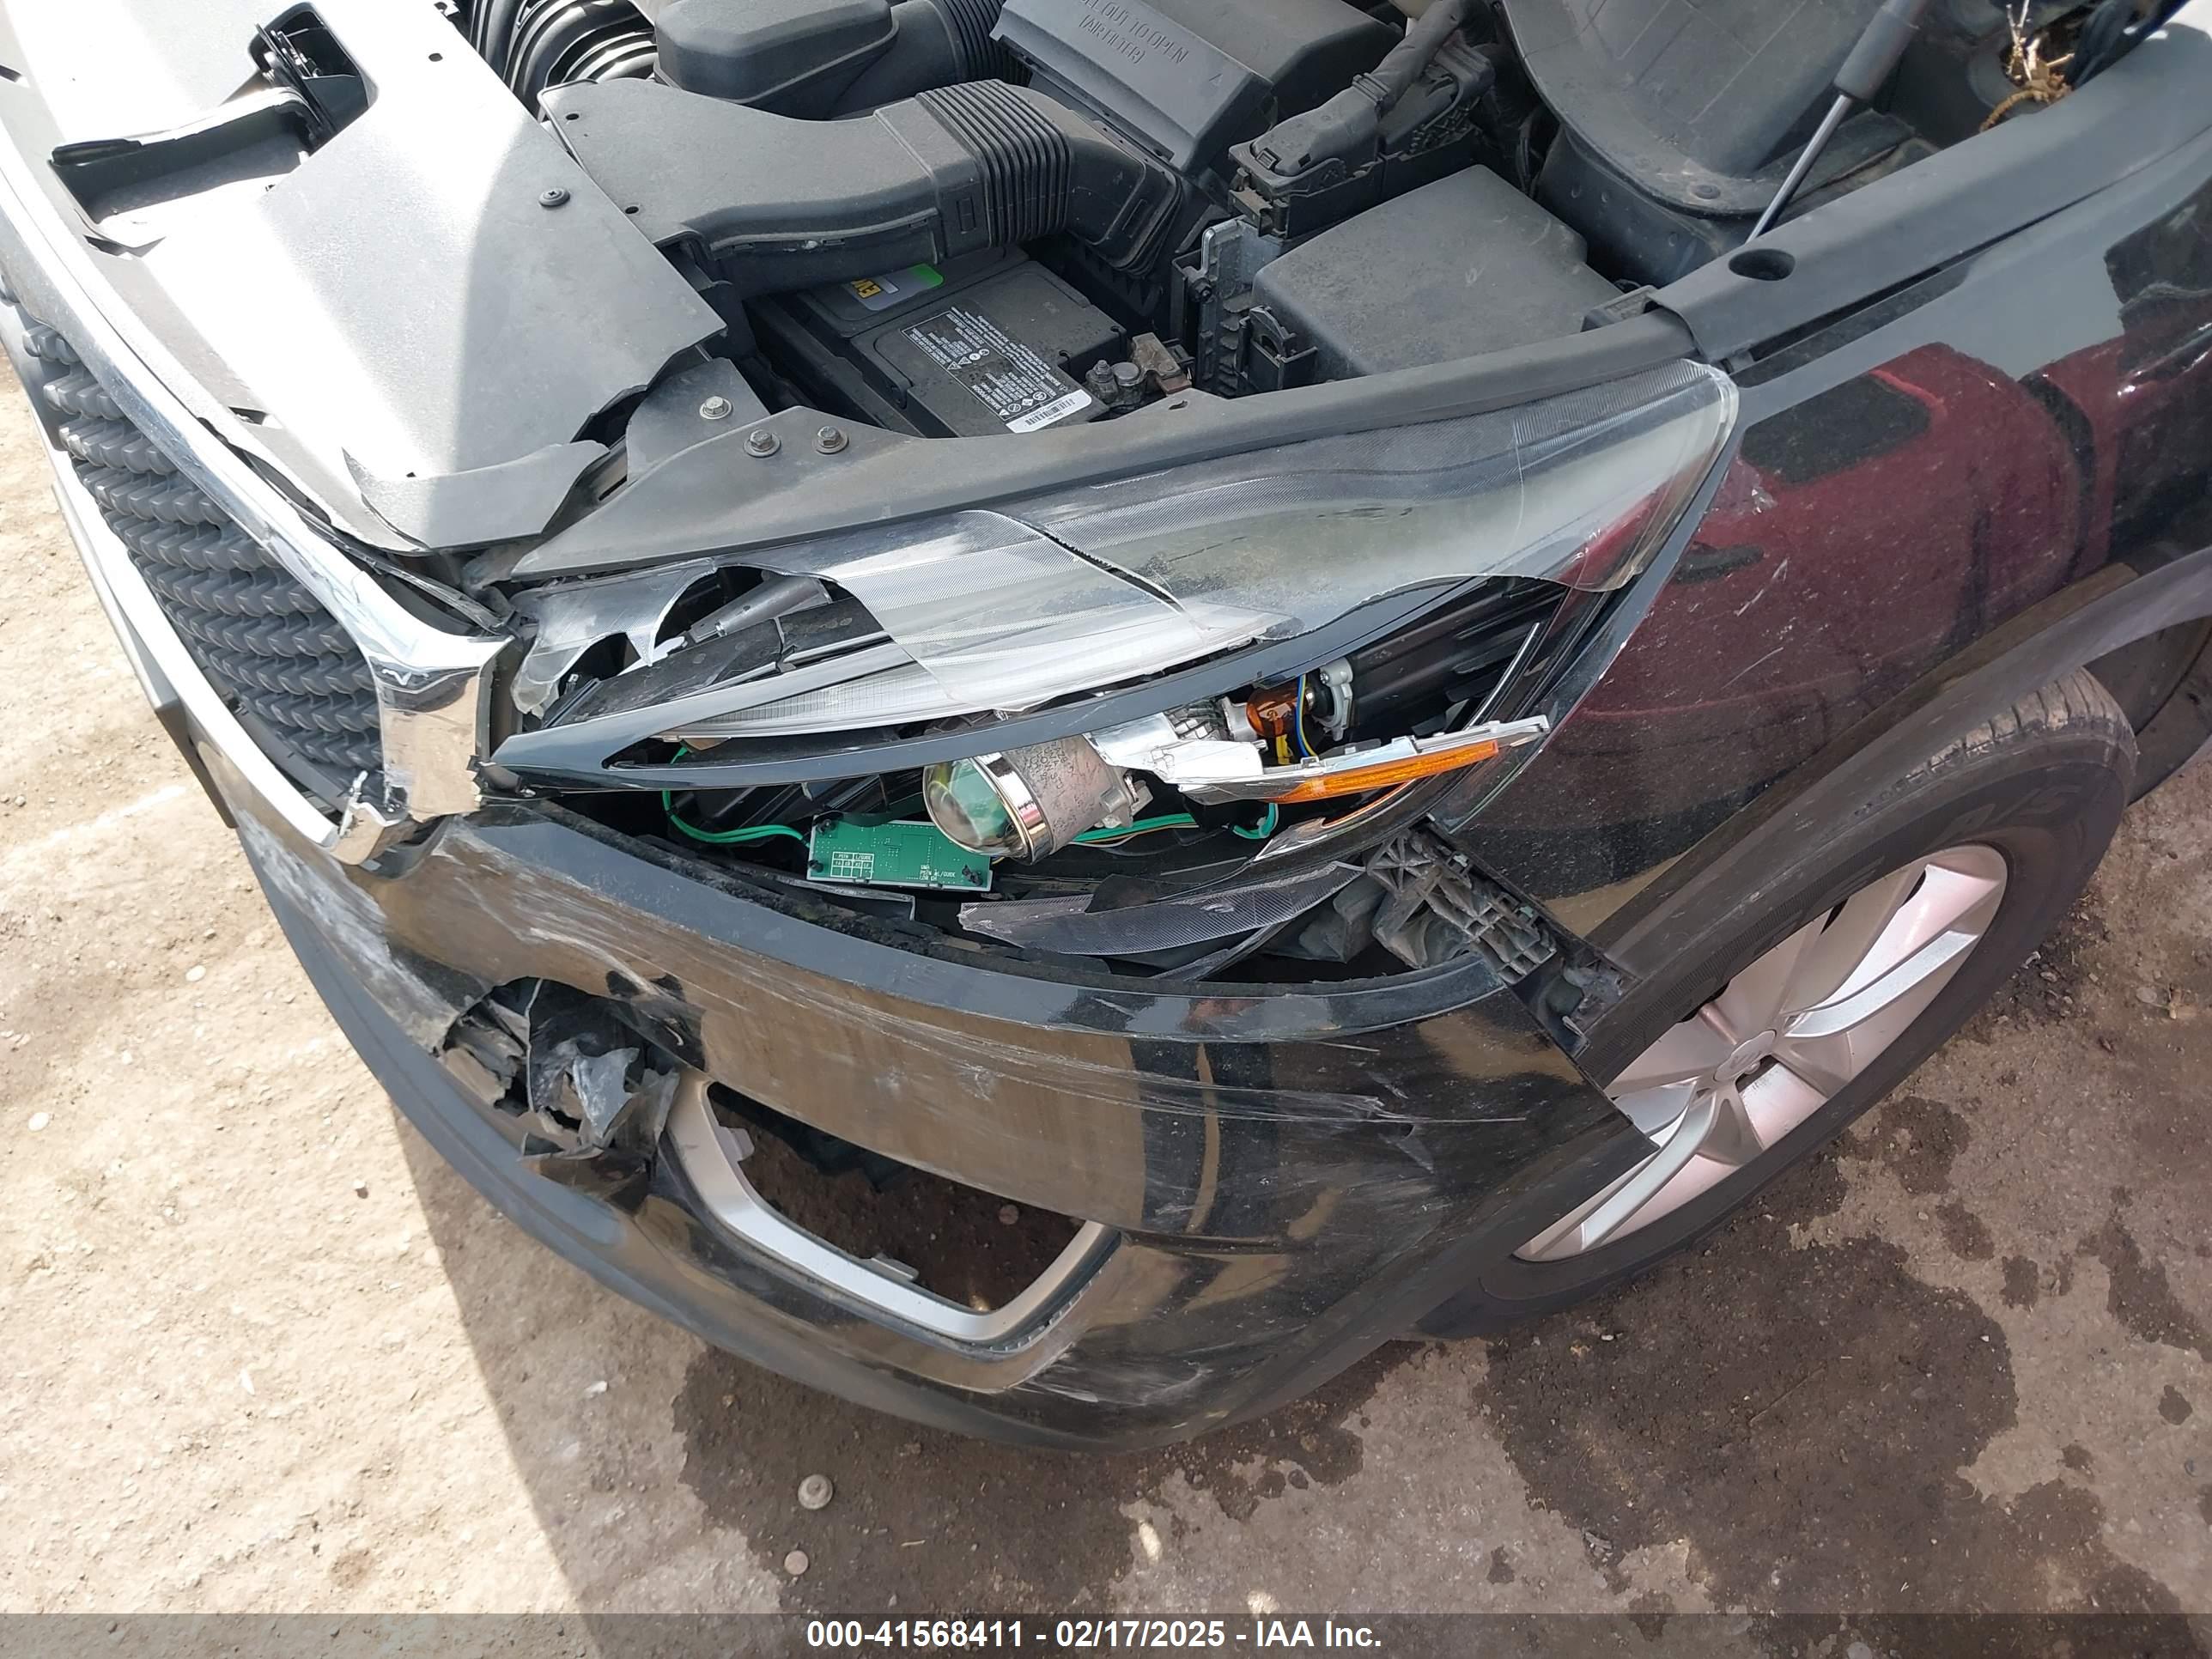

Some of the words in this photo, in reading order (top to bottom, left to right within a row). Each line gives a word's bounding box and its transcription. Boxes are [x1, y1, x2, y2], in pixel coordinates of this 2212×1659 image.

[1101, 2, 1131, 27] OUT
[1128, 17, 1152, 40] TO
[1146, 30, 1189, 64] OPEN
